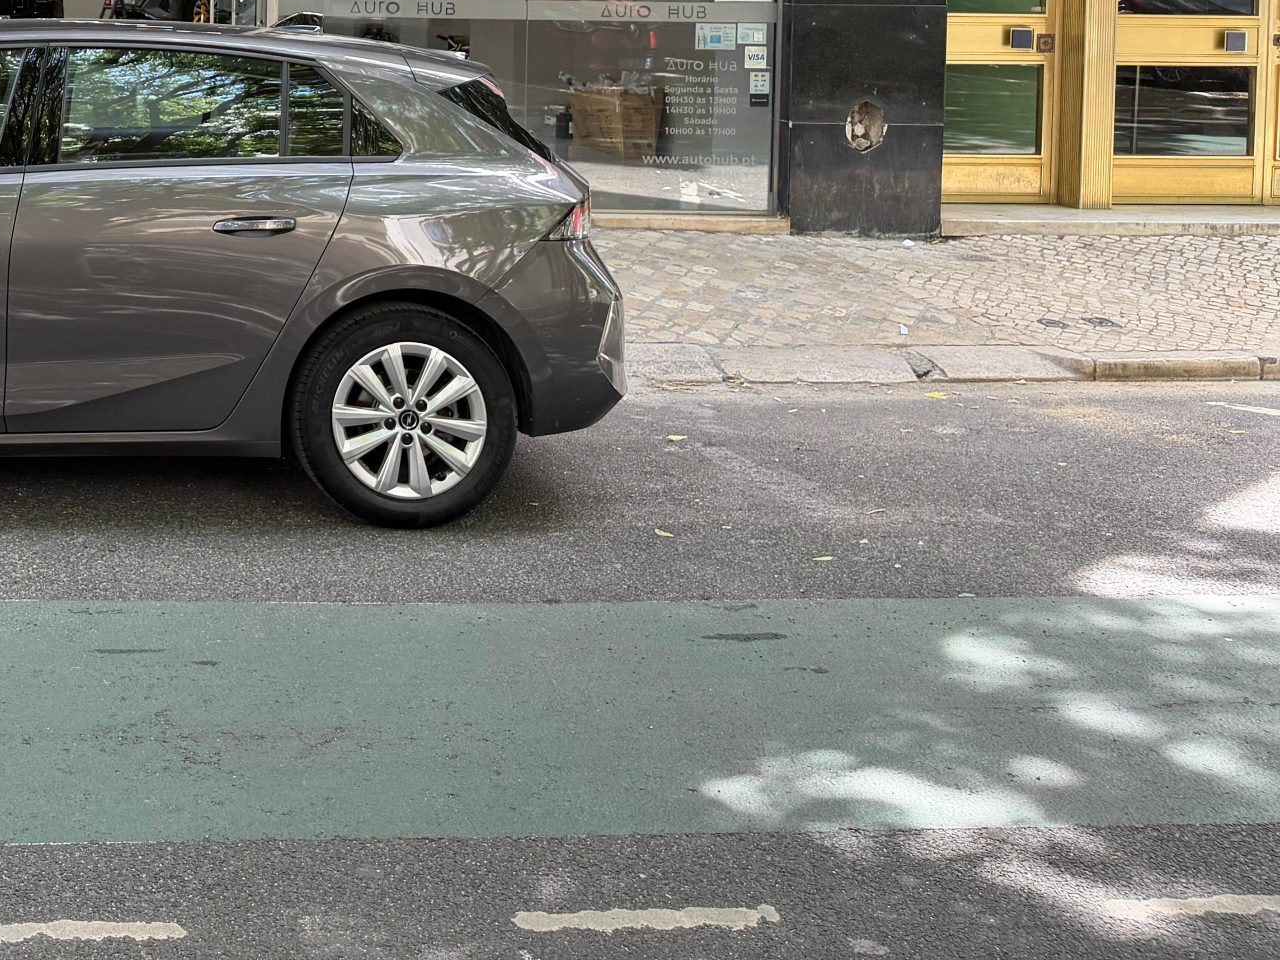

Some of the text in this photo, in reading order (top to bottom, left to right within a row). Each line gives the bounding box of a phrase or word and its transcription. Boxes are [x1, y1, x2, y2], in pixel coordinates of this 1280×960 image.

[350, 0, 456, 16] AUTO HUB
[601, 4, 707, 19] AUTO HUB
[748, 53, 765, 61] VISA
[666, 60, 737, 71] AUTO HUB
[685, 75, 718, 83] Horário
[664, 86, 703, 95] Segunda
[714, 86, 739, 94] Sexta
[665, 96, 693, 104] 09H30
[665, 106, 693, 114] 14H30
[683, 116, 717, 125] Sábado
[664, 127, 693, 135] 10H00
[642, 154, 755, 168] www.autohub.pt
